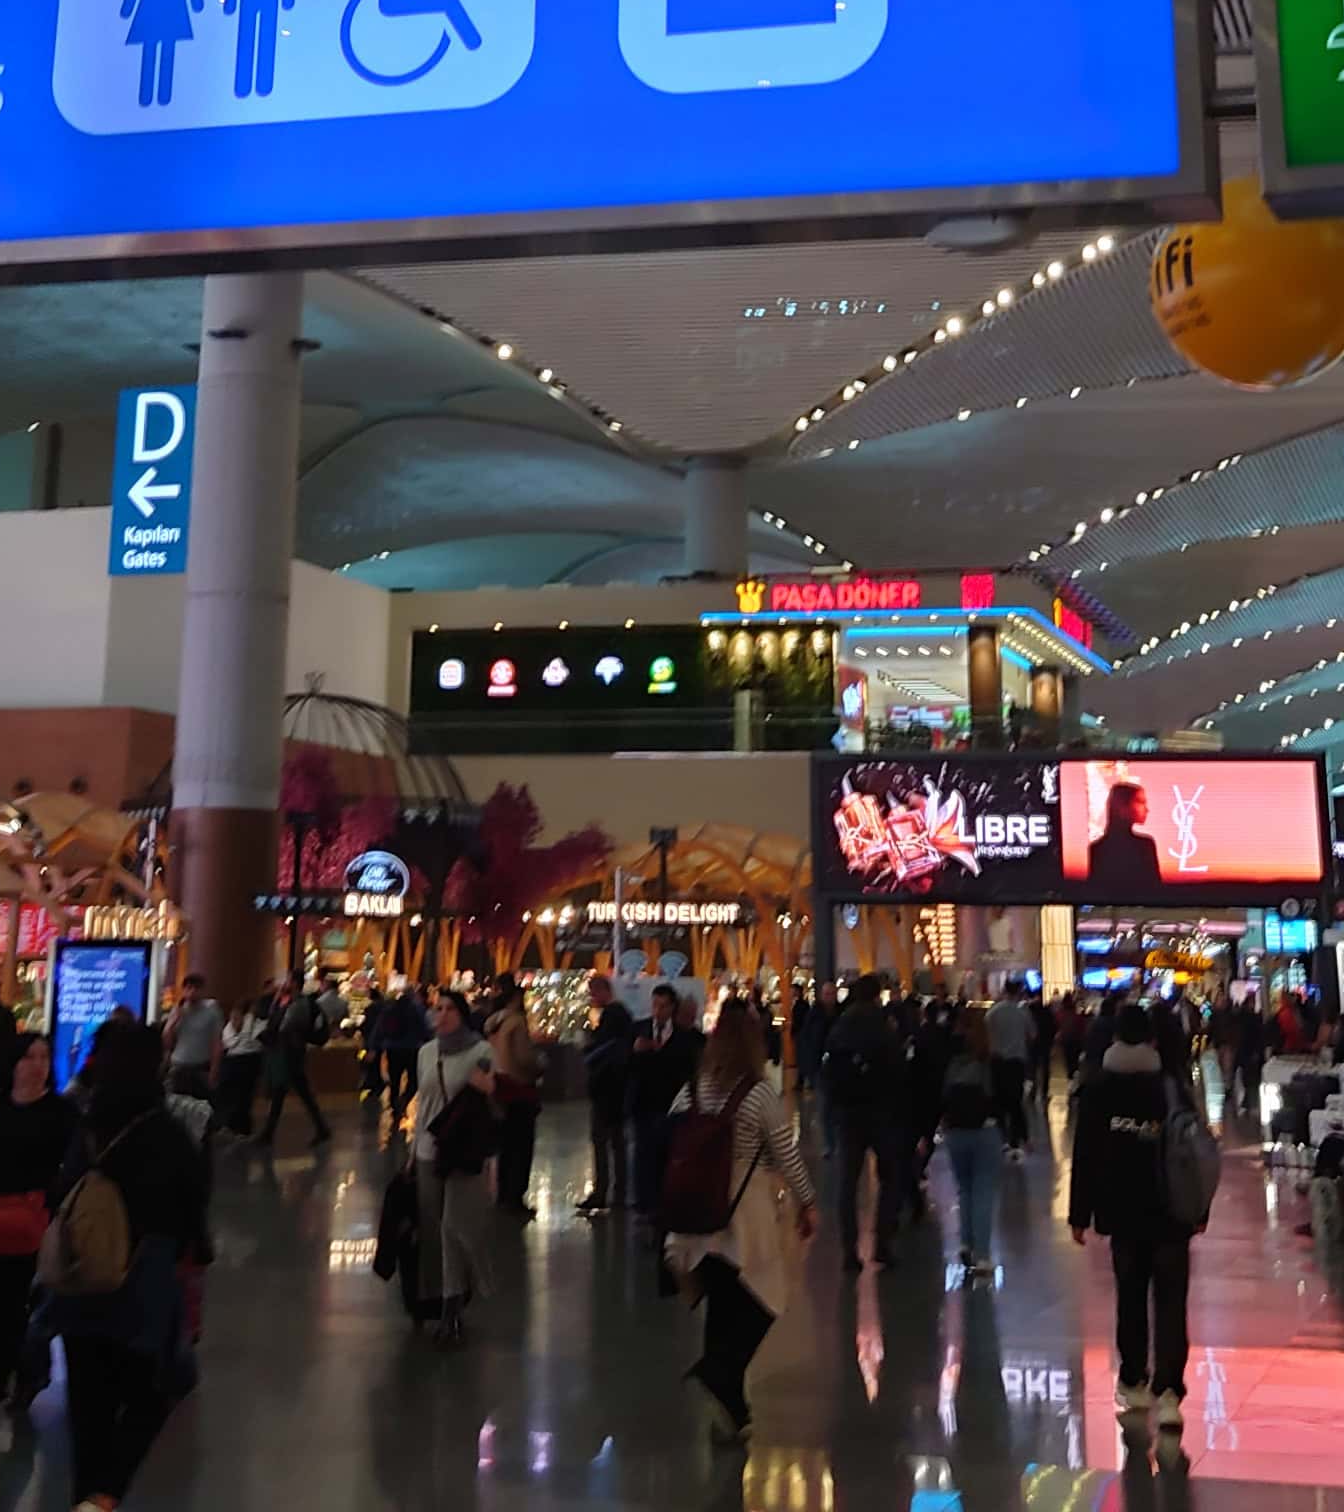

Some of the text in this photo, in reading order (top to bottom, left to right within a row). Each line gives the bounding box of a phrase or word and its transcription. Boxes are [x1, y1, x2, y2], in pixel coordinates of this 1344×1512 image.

[133, 391, 186, 463] D
[122, 549, 167, 569] Gates
[958, 815, 1049, 844] LIBRE
[664, 902, 740, 924] DELIGHT
